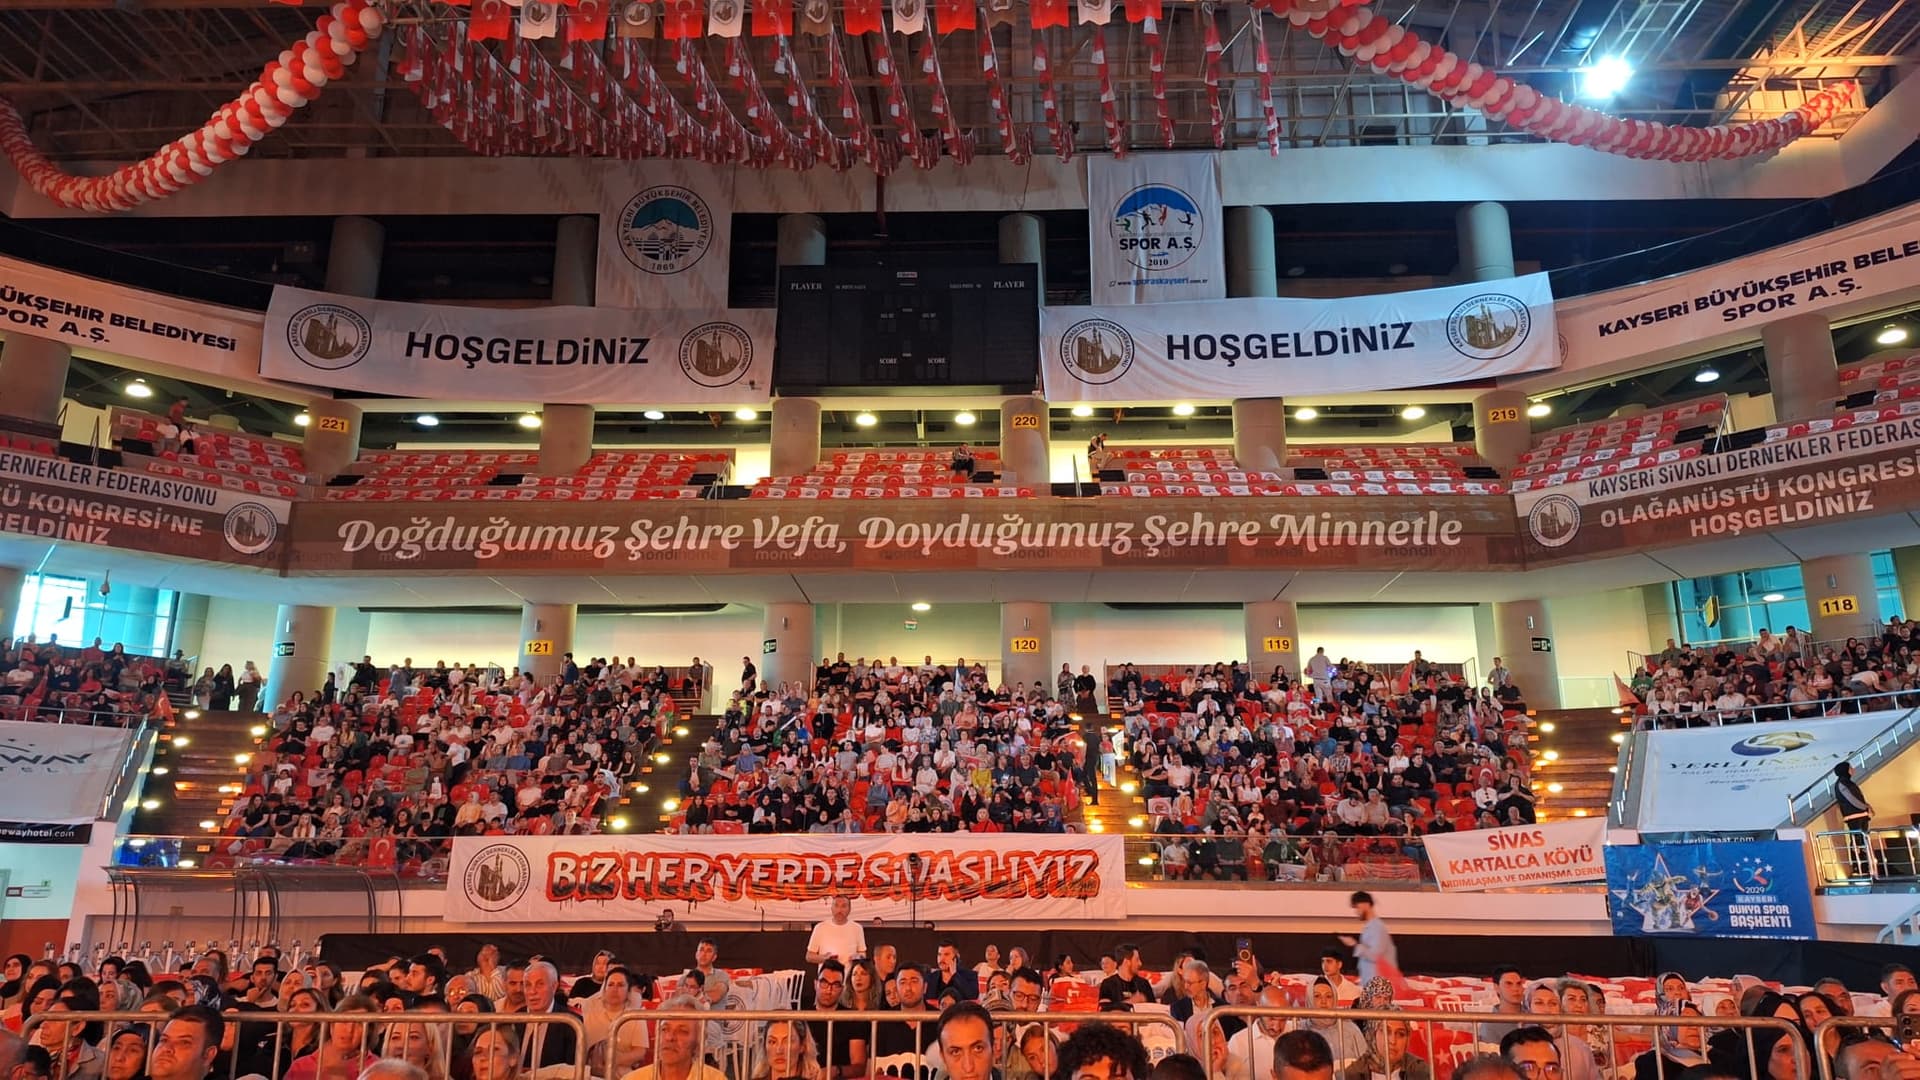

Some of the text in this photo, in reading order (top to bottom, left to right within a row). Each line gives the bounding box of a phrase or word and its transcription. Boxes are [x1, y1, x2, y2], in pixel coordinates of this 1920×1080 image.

[1119, 238, 1161, 250] SPOR
[1148, 258, 1169, 266] 2010
[790, 282, 823, 291] PLAYER
[993, 280, 1026, 289] PLAYER
[1723, 293, 1796, 322] SPOR
[879, 357, 898, 365] SCORE
[1015, 416, 1037, 426] 220
[1491, 408, 1517, 421] 219
[321, 418, 346, 431] 221
[1726, 435, 1832, 473] DERNEKLER
[96, 470, 218, 506] FEDERASYONU
[1601, 477, 1770, 528] OLAĞANÜSTÜ
[1690, 487, 1874, 537] HOŞGELDİNİZ
[338, 516, 620, 560] Doğduğumuz
[625, 516, 744, 560] Şehre
[752, 515, 847, 557] Vefa,
[858, 513, 1135, 555] Doyduğumuz
[1141, 512, 1261, 556] Şehre
[1270, 510, 1463, 552] Minnetle
[1823, 599, 1853, 613] 118
[527, 642, 549, 653] 121
[1014, 639, 1037, 651] 120
[1267, 638, 1290, 650] 119
[1488, 830, 1545, 851] SİVAS
[1449, 845, 1594, 875] KARTALCA KÖYÜ
[627, 856, 712, 897] HER
[719, 857, 859, 897] YERDE
[1505, 874, 1518, 882] VE
[1519, 869, 1573, 882] DAYANIŞMA
[1745, 886, 1766, 894] 2029
[1762, 904, 1790, 914] SPOR
